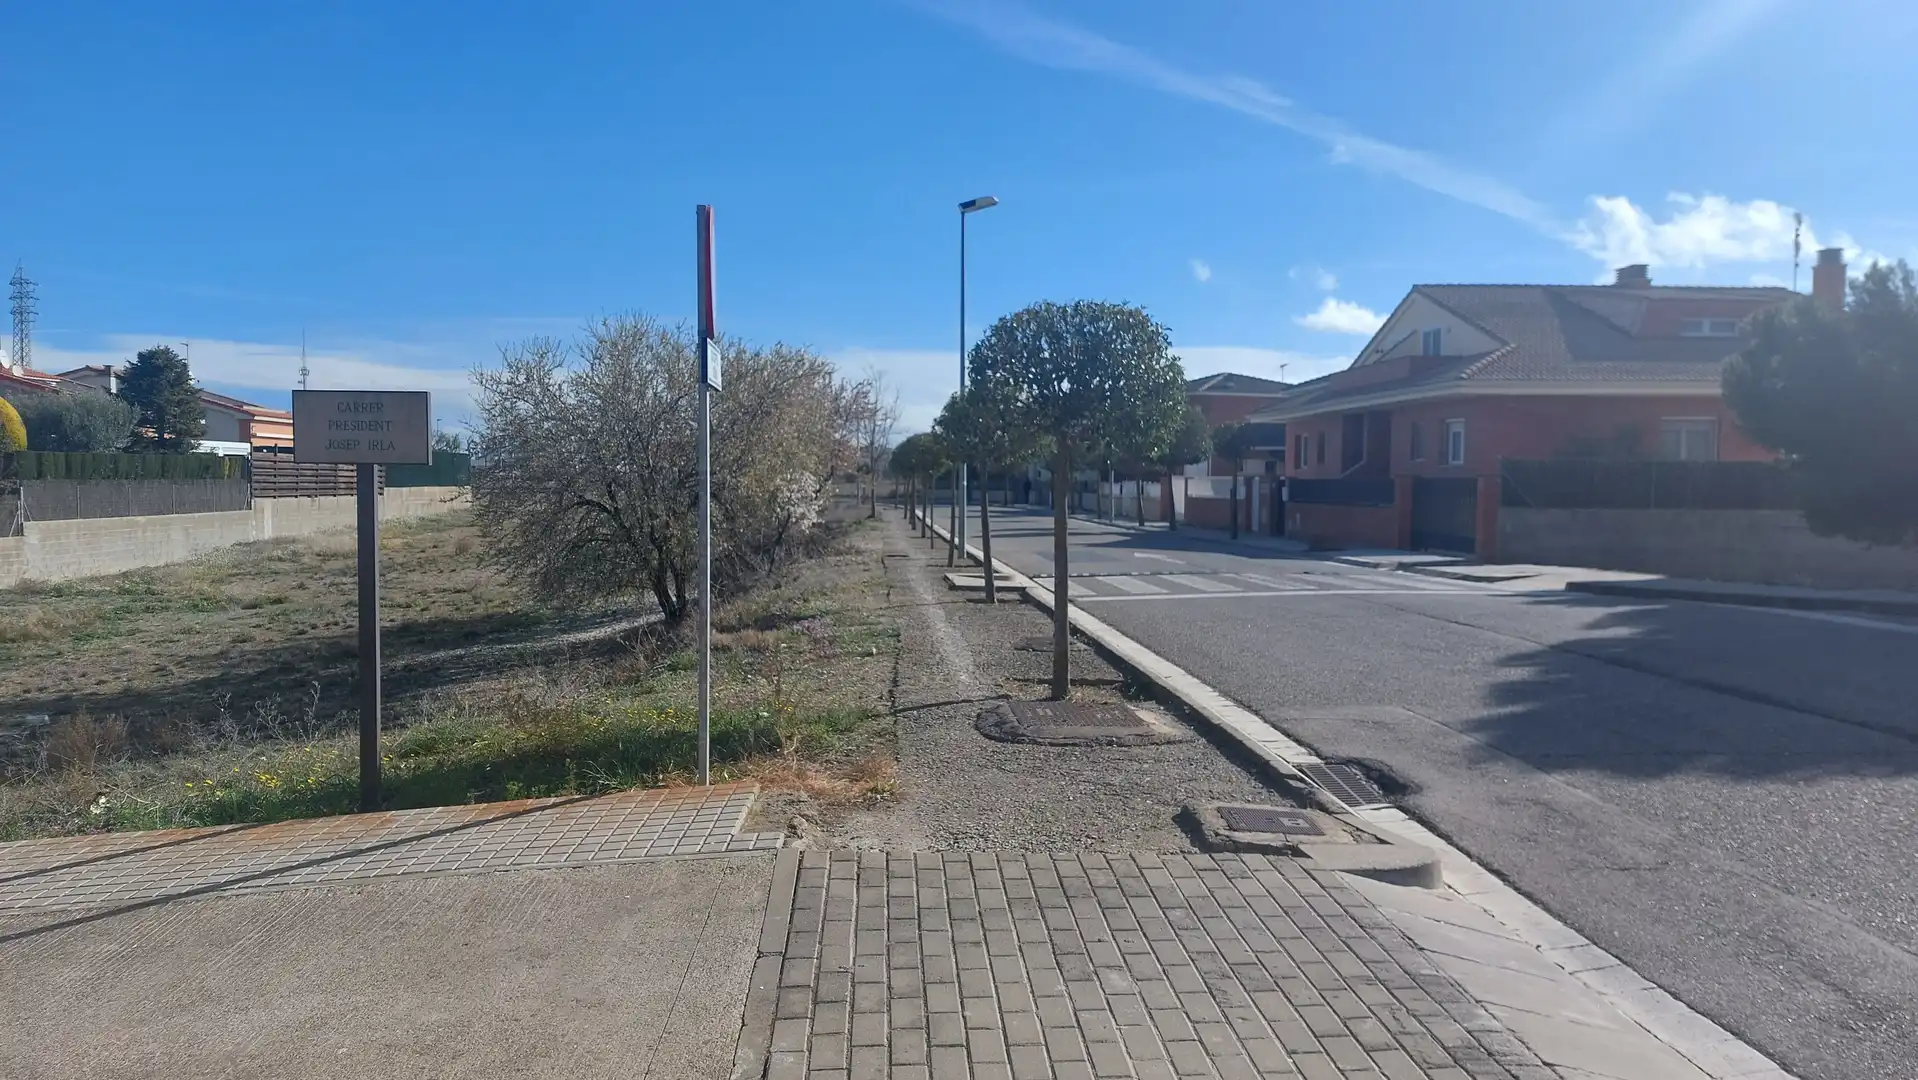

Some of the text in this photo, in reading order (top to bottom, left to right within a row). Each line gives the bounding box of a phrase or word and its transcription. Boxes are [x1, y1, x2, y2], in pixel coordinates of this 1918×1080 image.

[337, 402, 384, 413] CARRER
[328, 420, 393, 432] PRESIDENT
[325, 439, 395, 451] JOSEP IRLA
